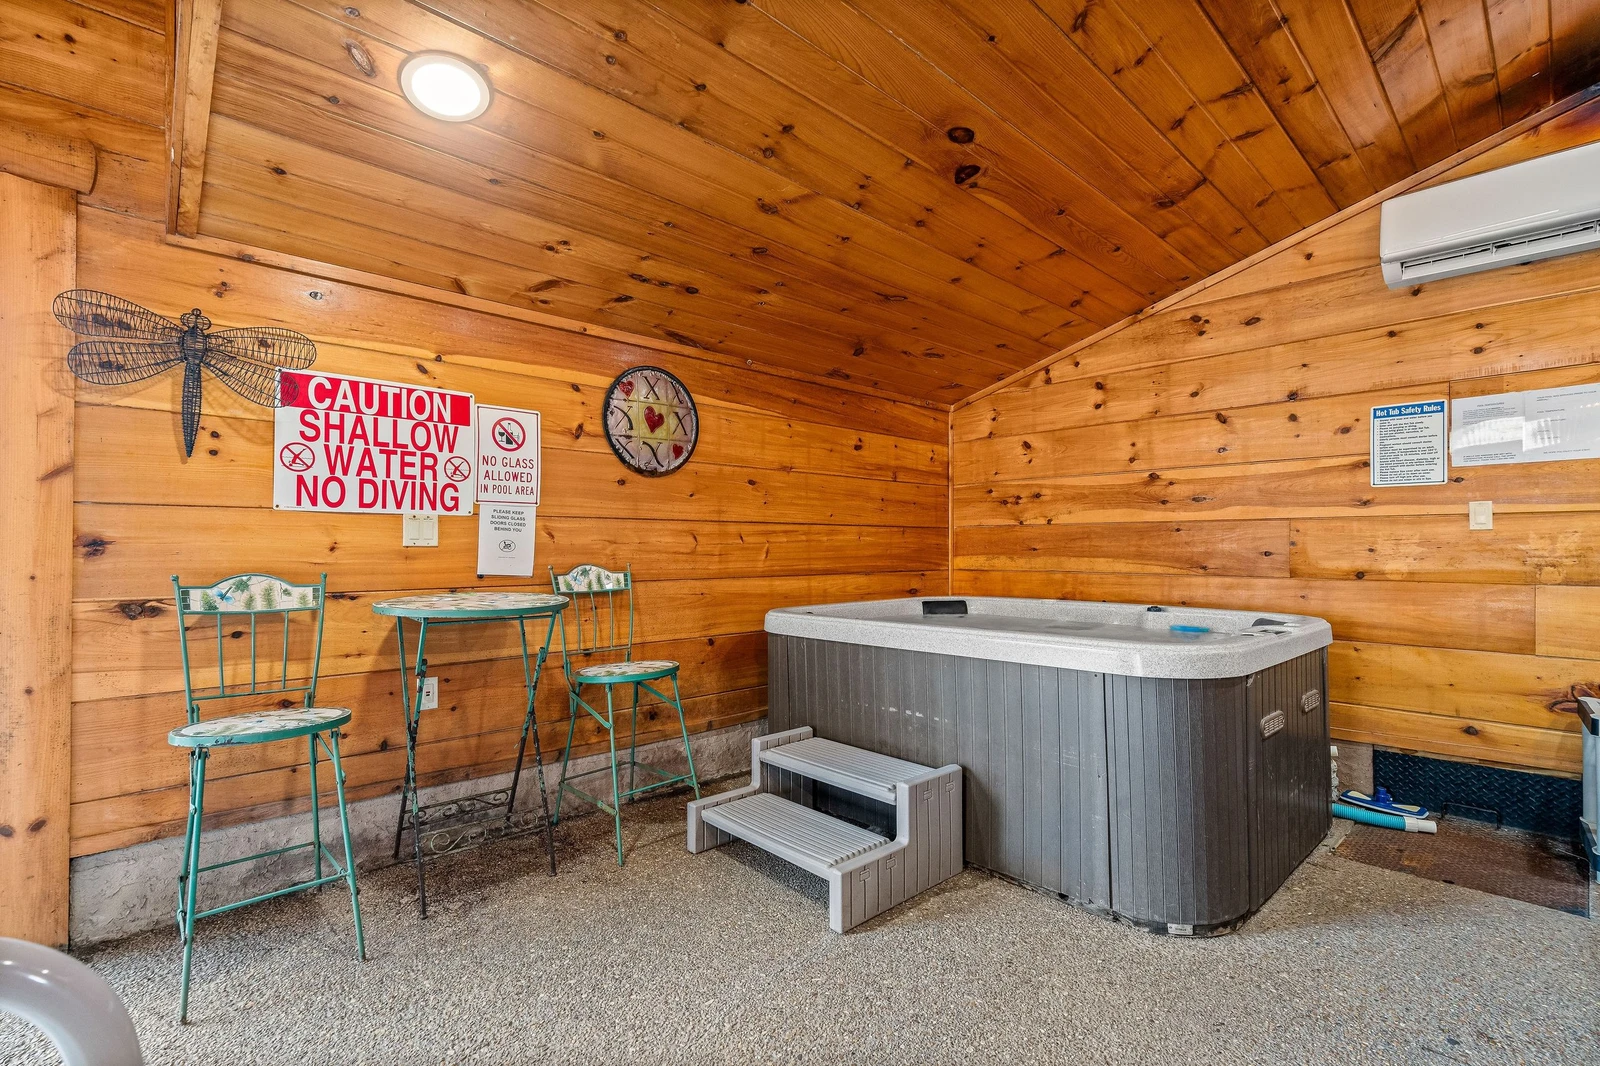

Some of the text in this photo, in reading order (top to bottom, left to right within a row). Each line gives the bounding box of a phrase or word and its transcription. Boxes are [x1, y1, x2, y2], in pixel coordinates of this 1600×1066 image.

[308, 376, 451, 424] CAUTION
[1376, 409, 1387, 417] Hot
[1401, 406, 1421, 414] Safety
[1423, 404, 1441, 412] Rules
[299, 409, 459, 453] SHALLOW
[323, 444, 438, 481] WATER
[482, 454, 534, 470] NO GLASS
[483, 469, 533, 483] ALLOWED
[296, 474, 459, 512] NO DIVING
[480, 483, 534, 496] IN POOL AREA
